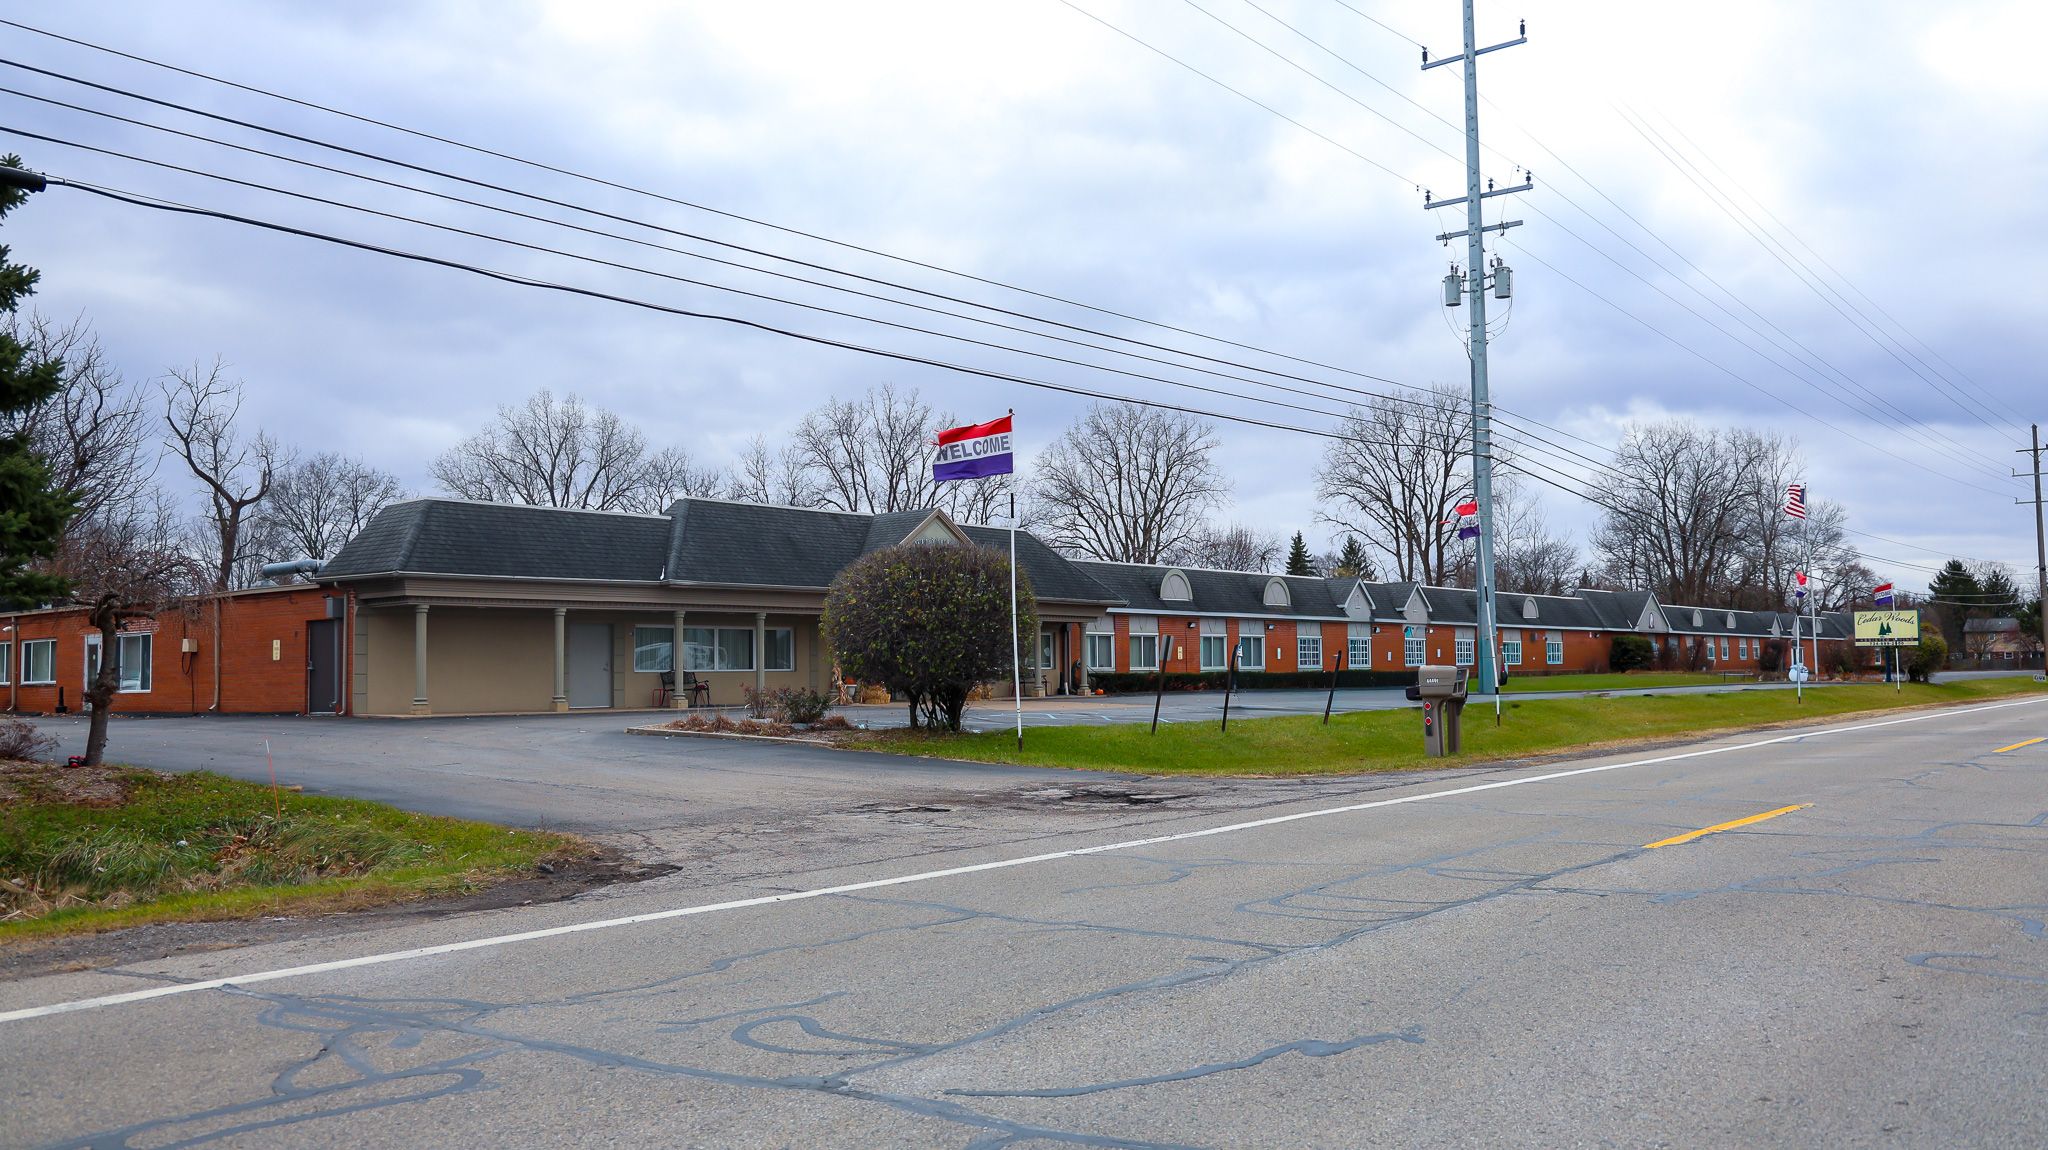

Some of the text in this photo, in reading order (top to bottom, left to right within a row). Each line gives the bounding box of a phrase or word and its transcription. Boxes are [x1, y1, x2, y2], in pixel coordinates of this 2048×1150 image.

[936, 435, 1010, 461] WELCOME
[1857, 612, 1914, 625] Cedar Woods
